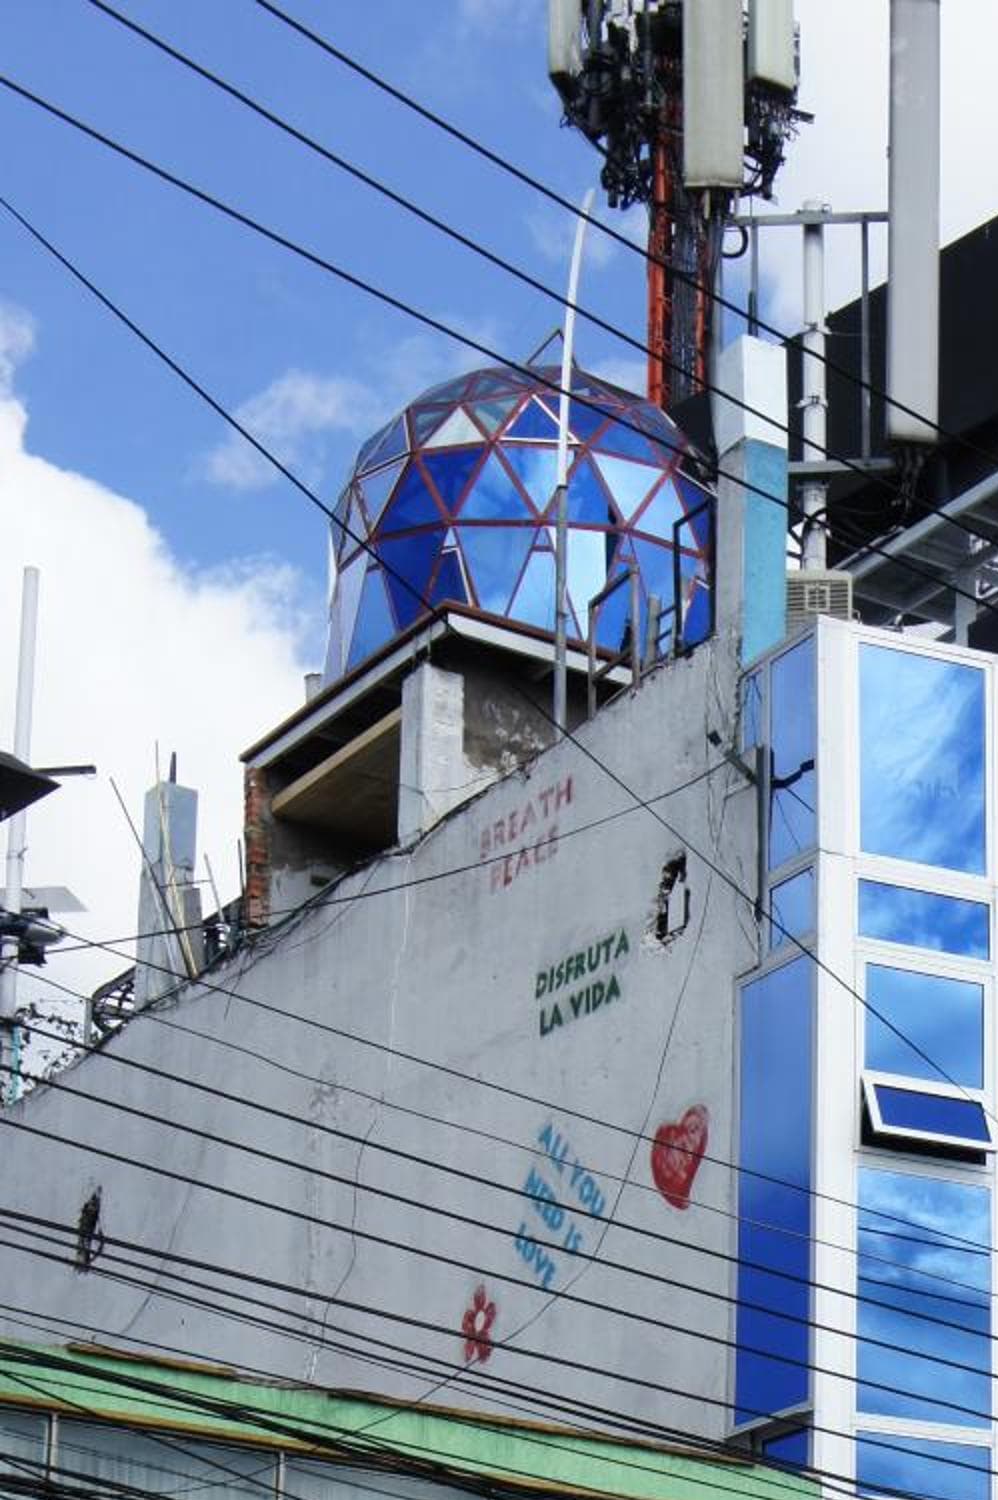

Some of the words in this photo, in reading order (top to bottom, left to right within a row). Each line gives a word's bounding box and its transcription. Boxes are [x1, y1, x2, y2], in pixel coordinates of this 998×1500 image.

[535, 927, 629, 999] DISFRUTA
[540, 1003, 563, 1036] LA
[570, 974, 620, 1019] VIDA
[538, 1124, 569, 1174] ALL
[570, 1158, 605, 1217] YOU
[515, 1221, 556, 1289] LOVE
[564, 1222, 583, 1254] IS
